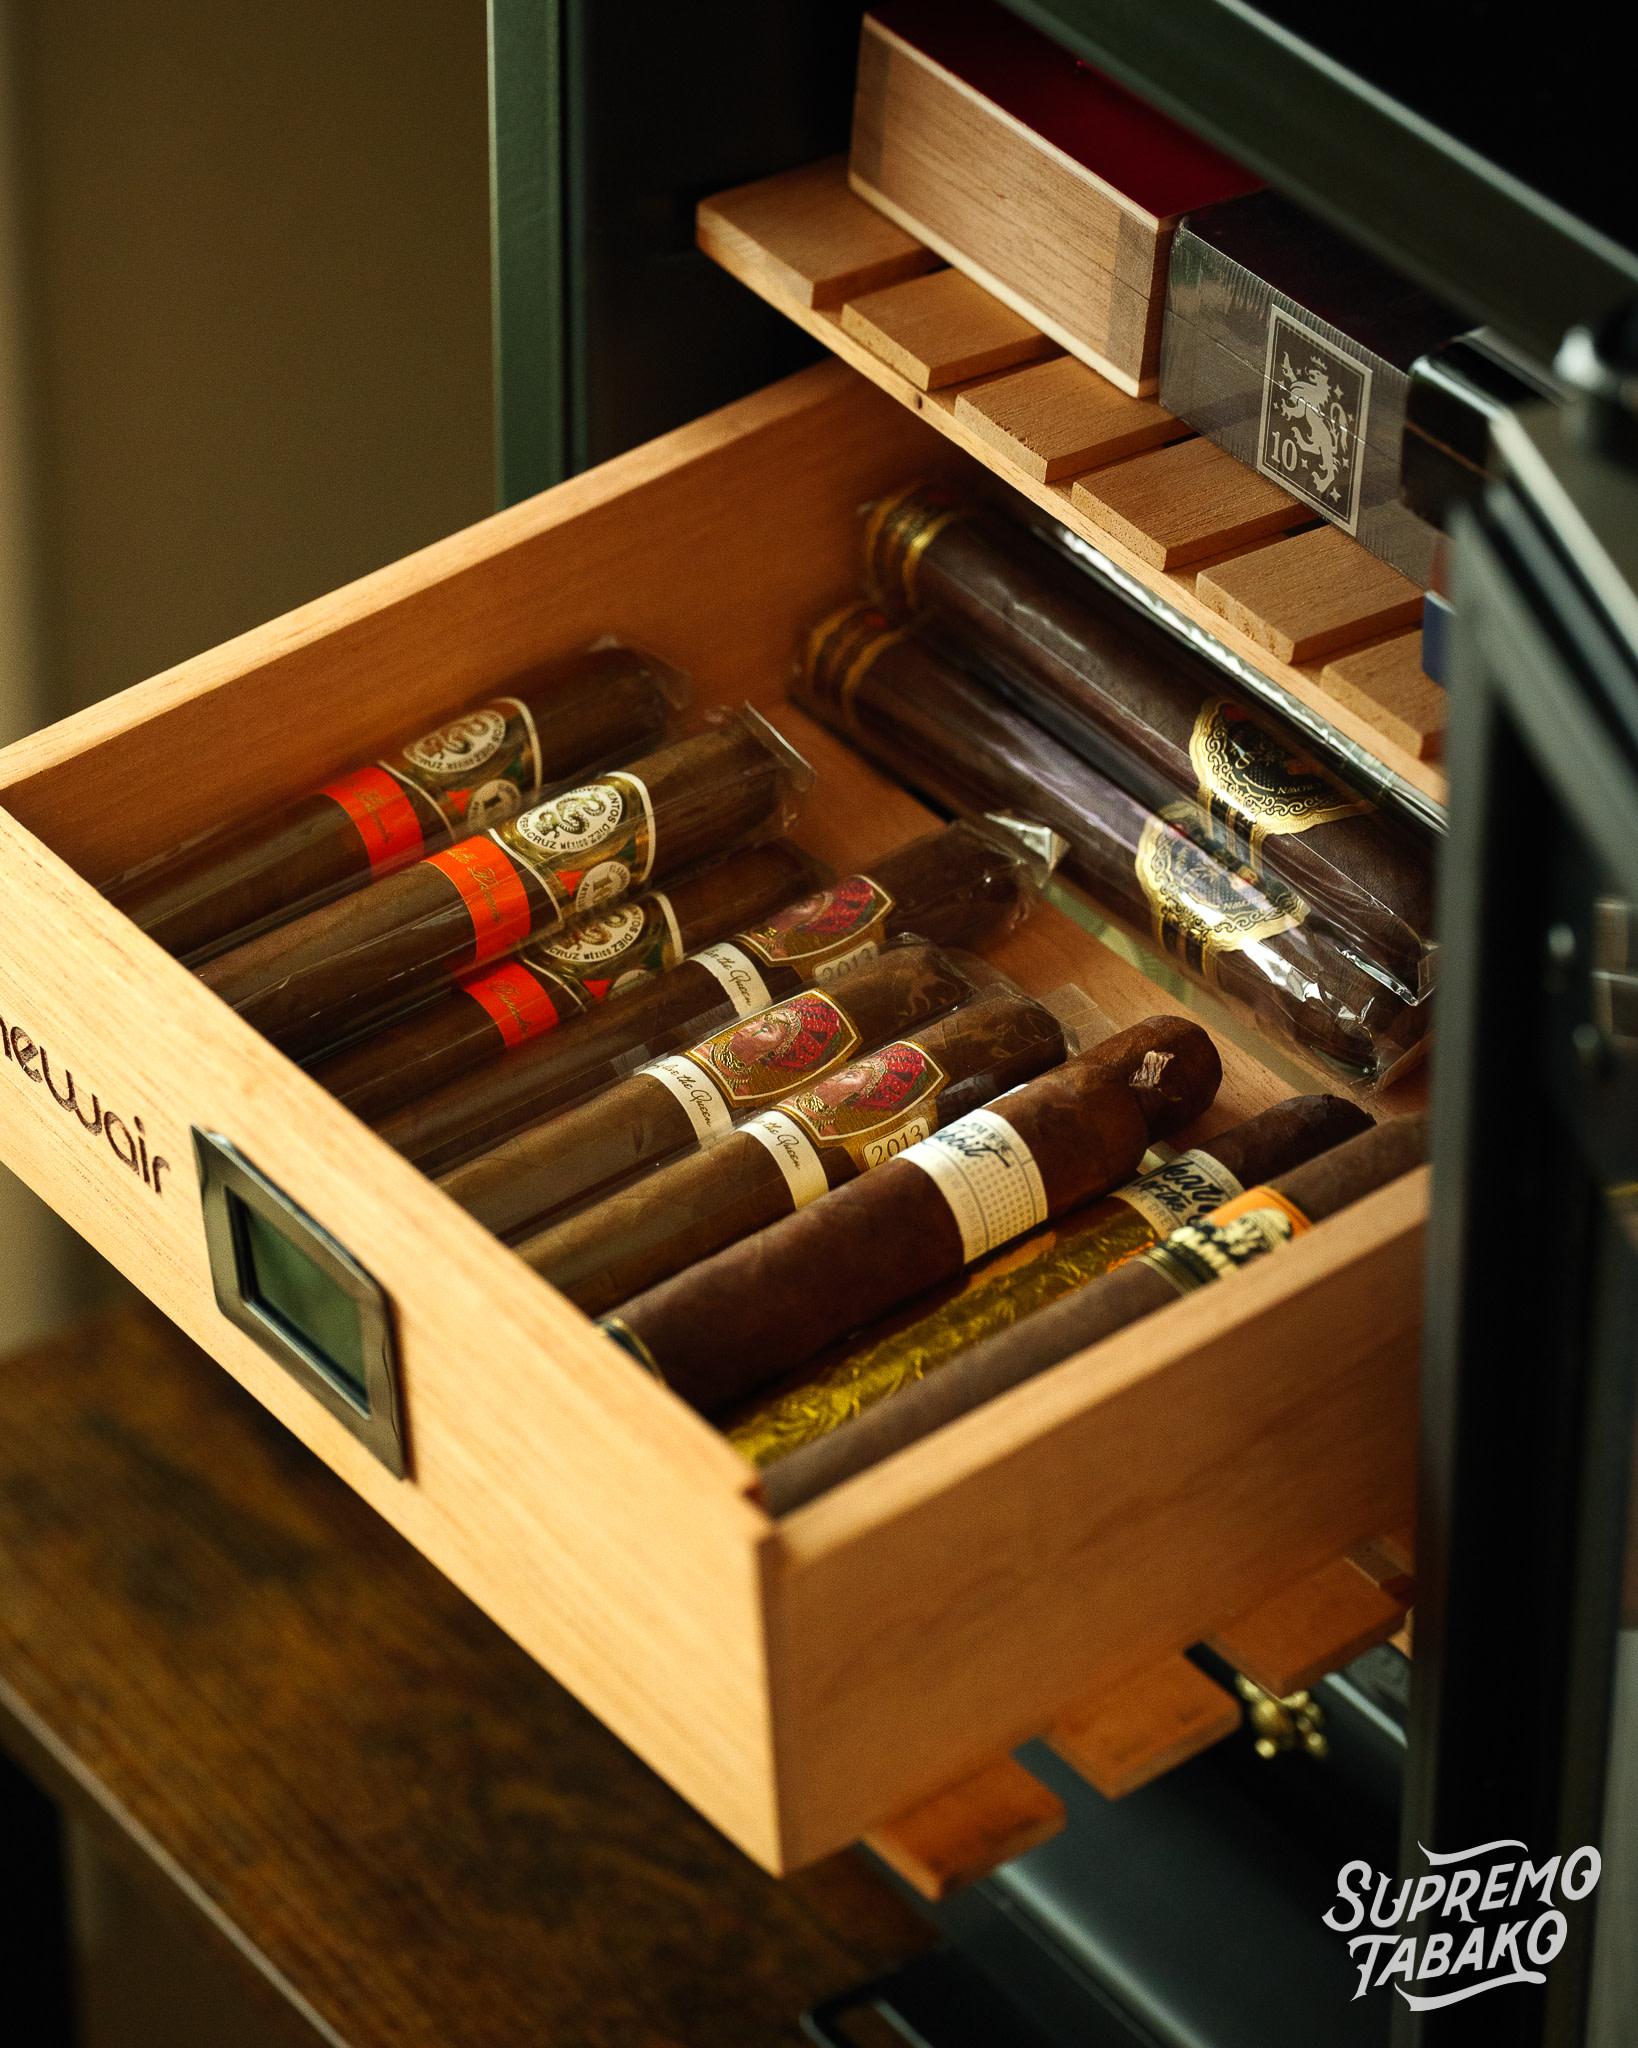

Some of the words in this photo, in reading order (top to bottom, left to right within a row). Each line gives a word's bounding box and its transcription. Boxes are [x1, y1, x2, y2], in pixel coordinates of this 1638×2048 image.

[1271, 430, 1298, 473] 10
[610, 932, 634, 954] DIEZ
[716, 957, 736, 971] the
[728, 969, 752, 1006] Queen
[676, 1074, 697, 1090] the
[689, 1089, 713, 1127] Queen
[762, 1121, 782, 1136] the
[775, 1133, 800, 1170] Queen
[871, 1124, 924, 1168] 2013
